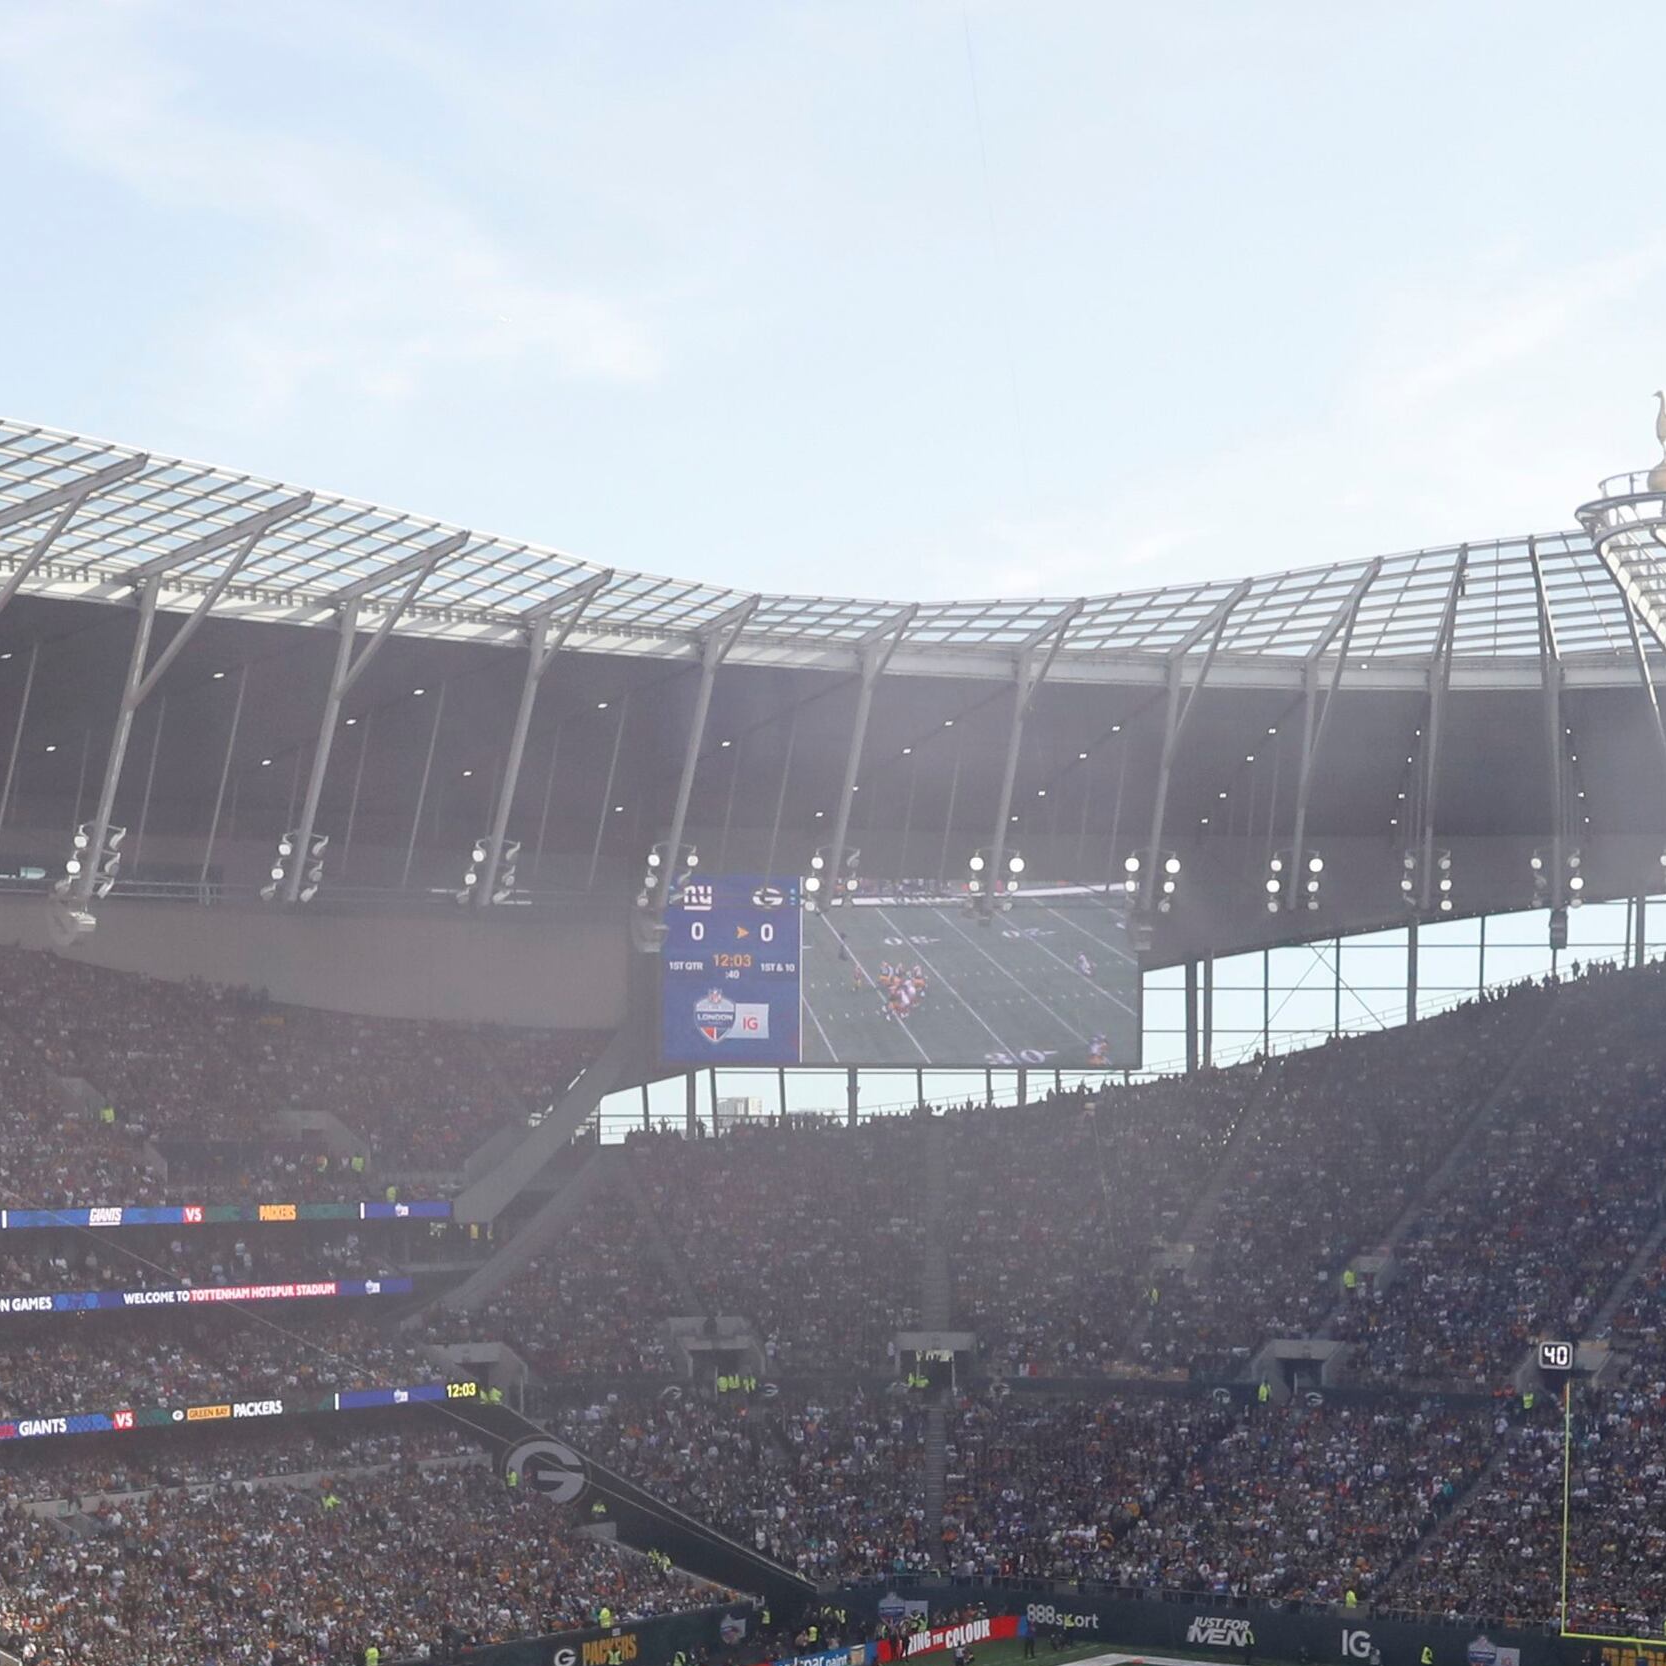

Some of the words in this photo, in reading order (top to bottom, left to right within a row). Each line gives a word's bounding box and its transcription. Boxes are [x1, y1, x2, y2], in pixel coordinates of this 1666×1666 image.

[691, 922, 704, 941] 0
[761, 923, 774, 942] 0
[713, 954, 752, 968] 12:03
[785, 963, 796, 972] 10
[743, 1018, 758, 1031] IG
[89, 1207, 123, 1226] GIANTS
[184, 1206, 202, 1221] VS
[259, 1204, 297, 1221] PACKERS
[123, 1289, 175, 1306] WELCOME
[176, 1290, 190, 1303] TO
[191, 1286, 250, 1301] TOTTENHAM
[251, 1284, 294, 1299] HOTSPUR
[296, 1283, 336, 1296] STADIUM
[11, 1296, 52, 1312] GAMES
[1542, 1345, 1570, 1366] 40
[446, 1383, 477, 1399] 12:03
[188, 1407, 213, 1419] GREEN
[214, 1406, 229, 1417] BAY
[233, 1400, 283, 1418] PACKERS
[19, 1418, 67, 1437] GIANTS
[115, 1412, 133, 1428] VS
[1194, 1616, 1223, 1629] JUST
[1222, 1618, 1251, 1631] FOR
[945, 1618, 991, 1649] COLOUR
[1187, 1625, 1249, 1647] MEN
[1340, 1628, 1372, 1658] IG
